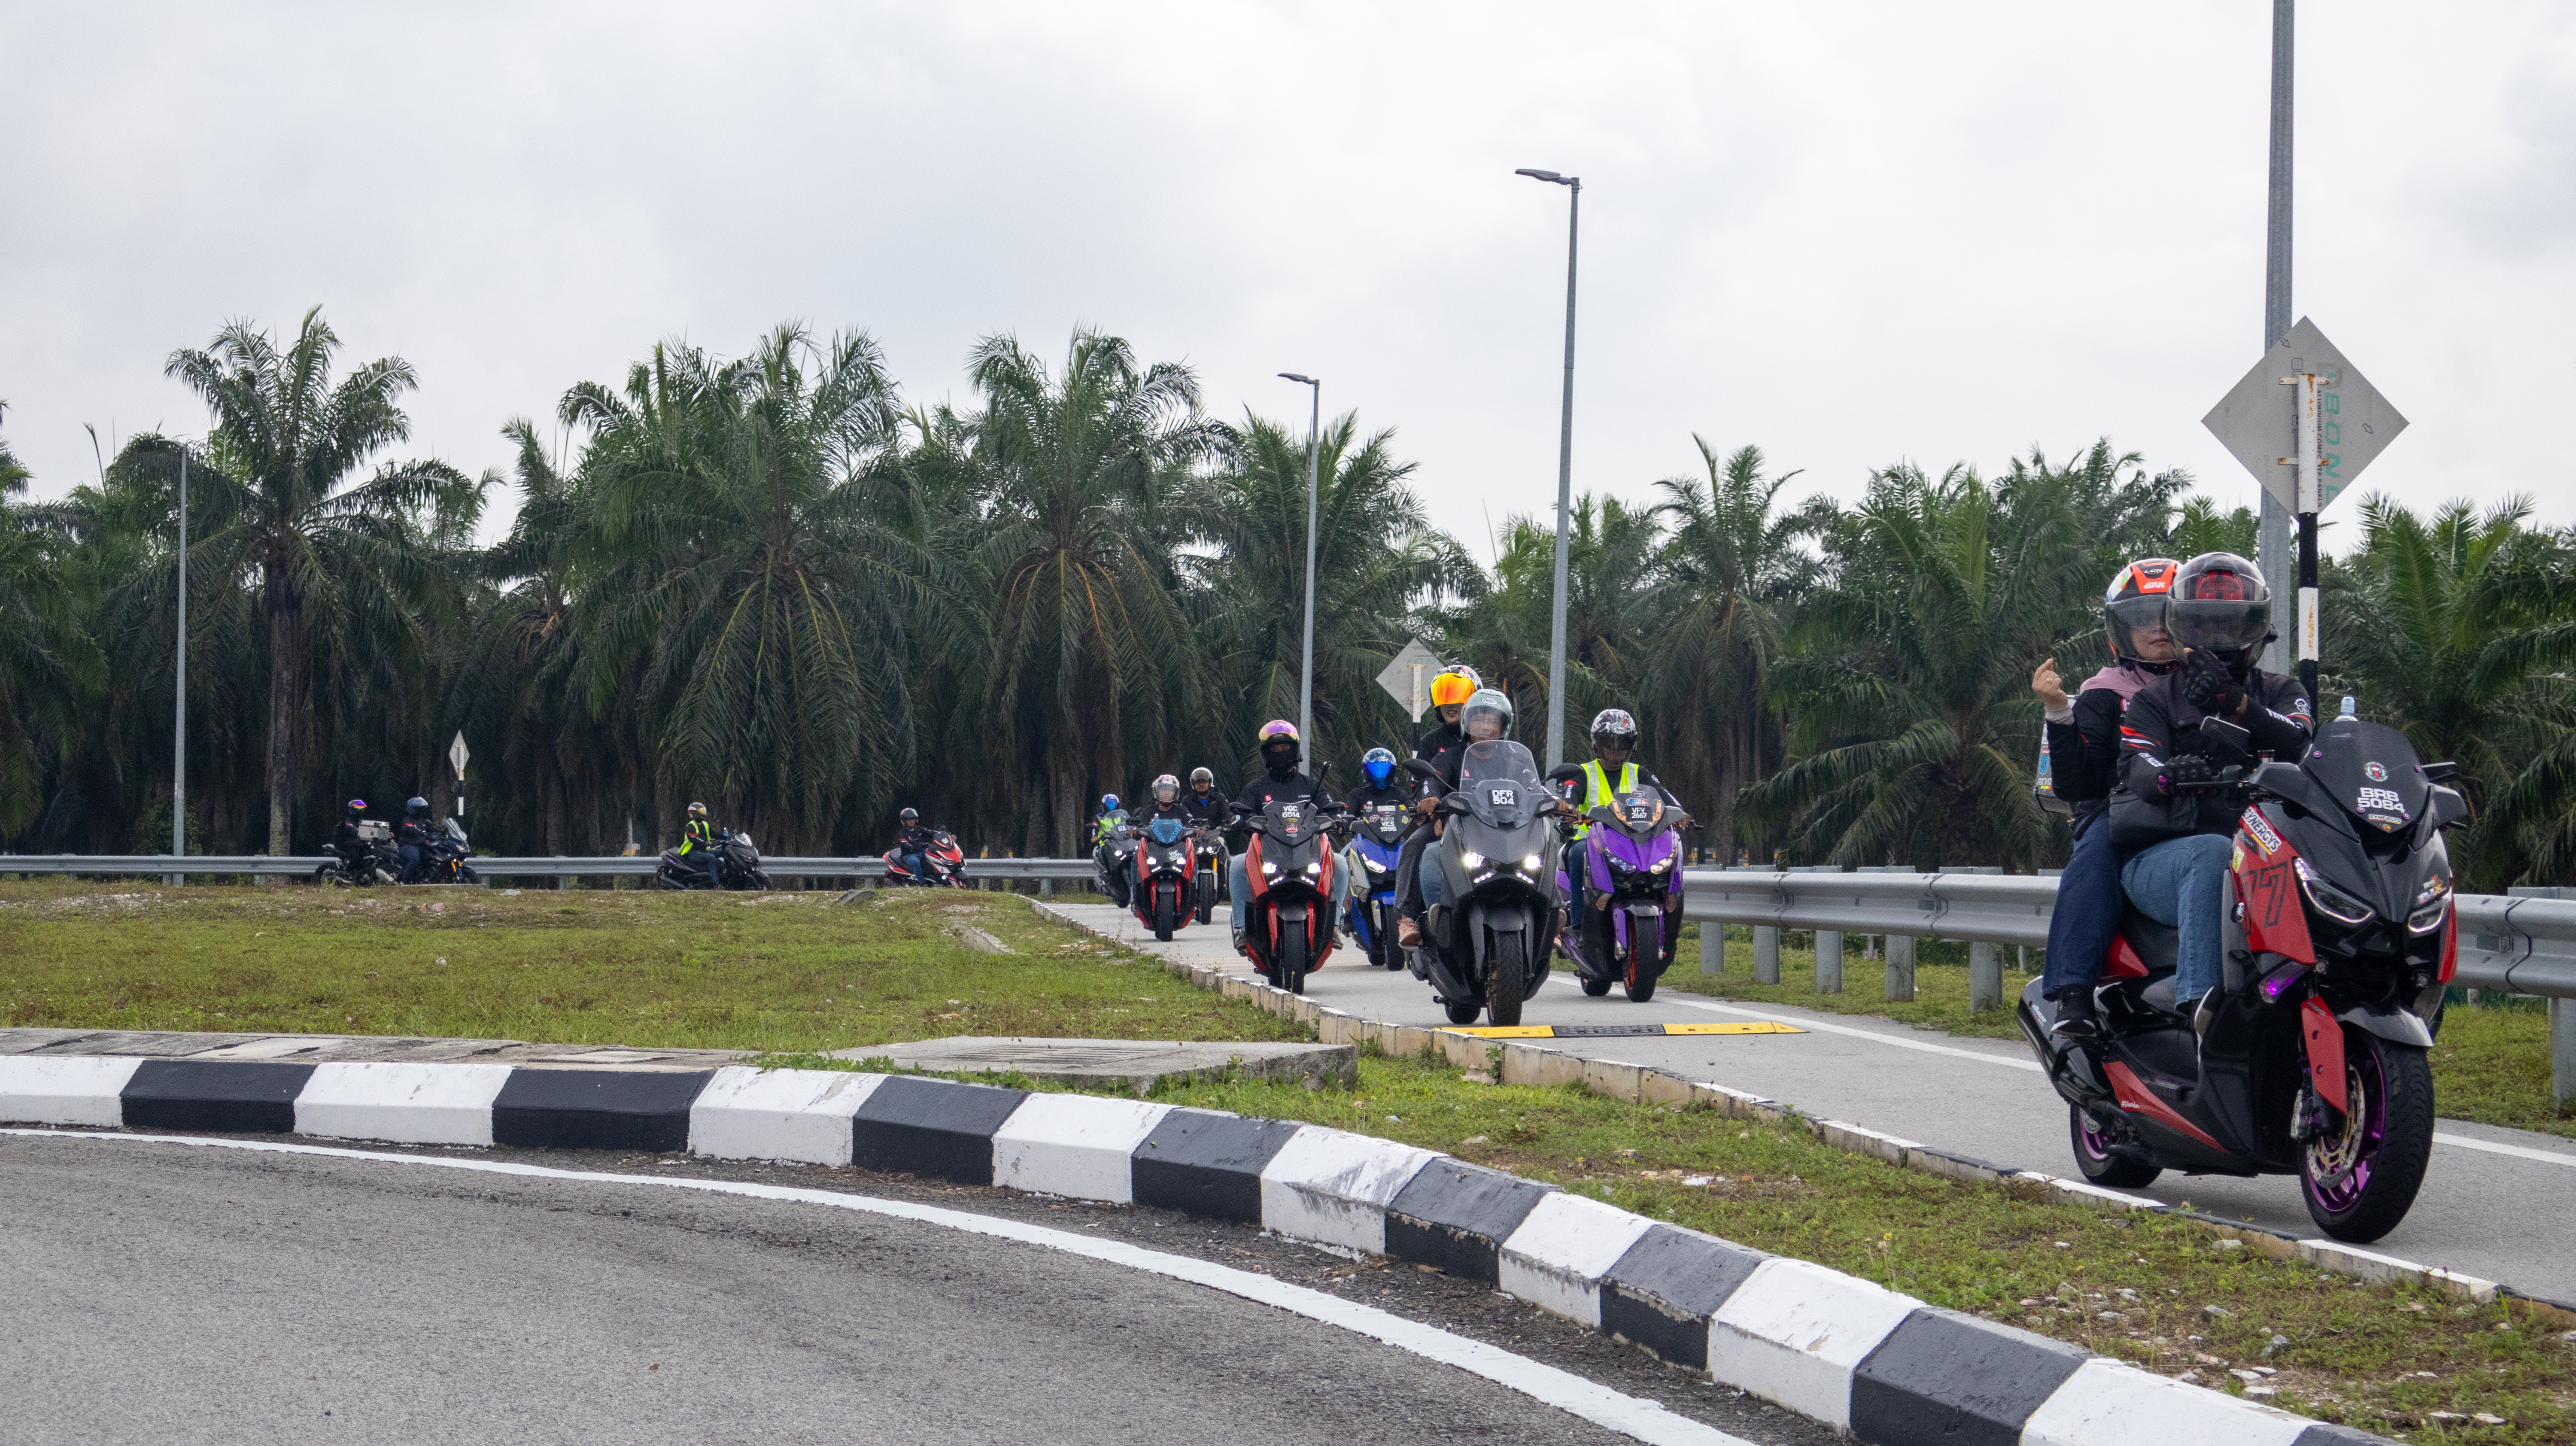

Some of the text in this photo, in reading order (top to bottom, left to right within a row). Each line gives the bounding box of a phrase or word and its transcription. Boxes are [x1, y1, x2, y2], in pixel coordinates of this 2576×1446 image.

[2360, 787, 2399, 802] BRB
[2357, 797, 2406, 813] 5084
[2242, 808, 2281, 851] ZYNERGYS
[2307, 1002, 2326, 1016] ABS
